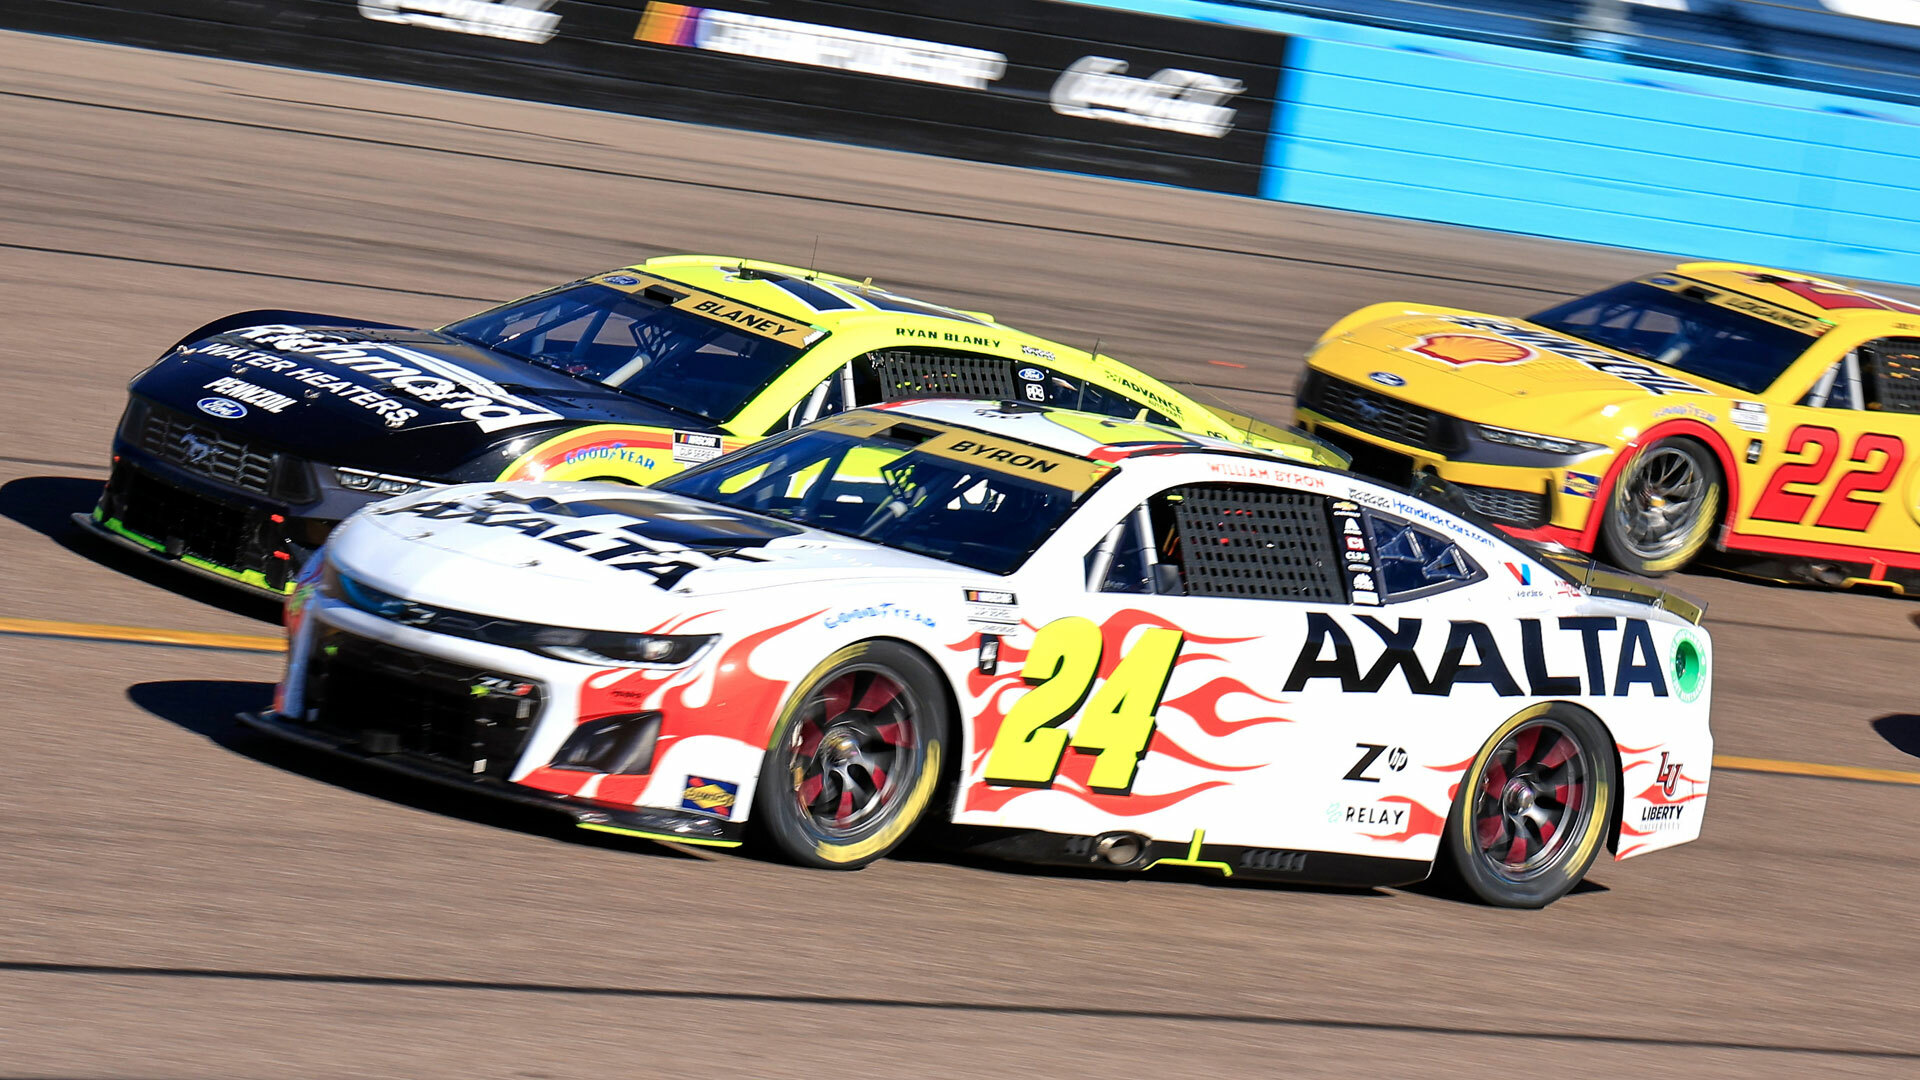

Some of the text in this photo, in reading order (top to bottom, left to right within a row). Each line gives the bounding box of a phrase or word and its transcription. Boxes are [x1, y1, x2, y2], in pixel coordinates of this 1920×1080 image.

[692, 300, 796, 337] BLANEY
[896, 328, 1000, 348] RYAN BLANEY
[197, 343, 420, 423] WATER HEATERS
[203, 376, 298, 414] PENNZOIL
[222, 324, 564, 434] Richmond
[1122, 379, 1183, 415] ADVANCE
[202, 399, 243, 417] Ford
[1148, 400, 1166, 411] AUTO
[949, 440, 1059, 474] BYRON
[1207, 463, 1325, 488] WILLIAM BYRON
[1750, 424, 1905, 532] 22
[1282, 612, 1669, 697] AXALTA
[984, 616, 1184, 796] 24
[1342, 742, 1389, 783] Z
[1656, 751, 1684, 797] LU
[1346, 806, 1404, 825] RELAY
[1642, 805, 1684, 821] LIBERTY
